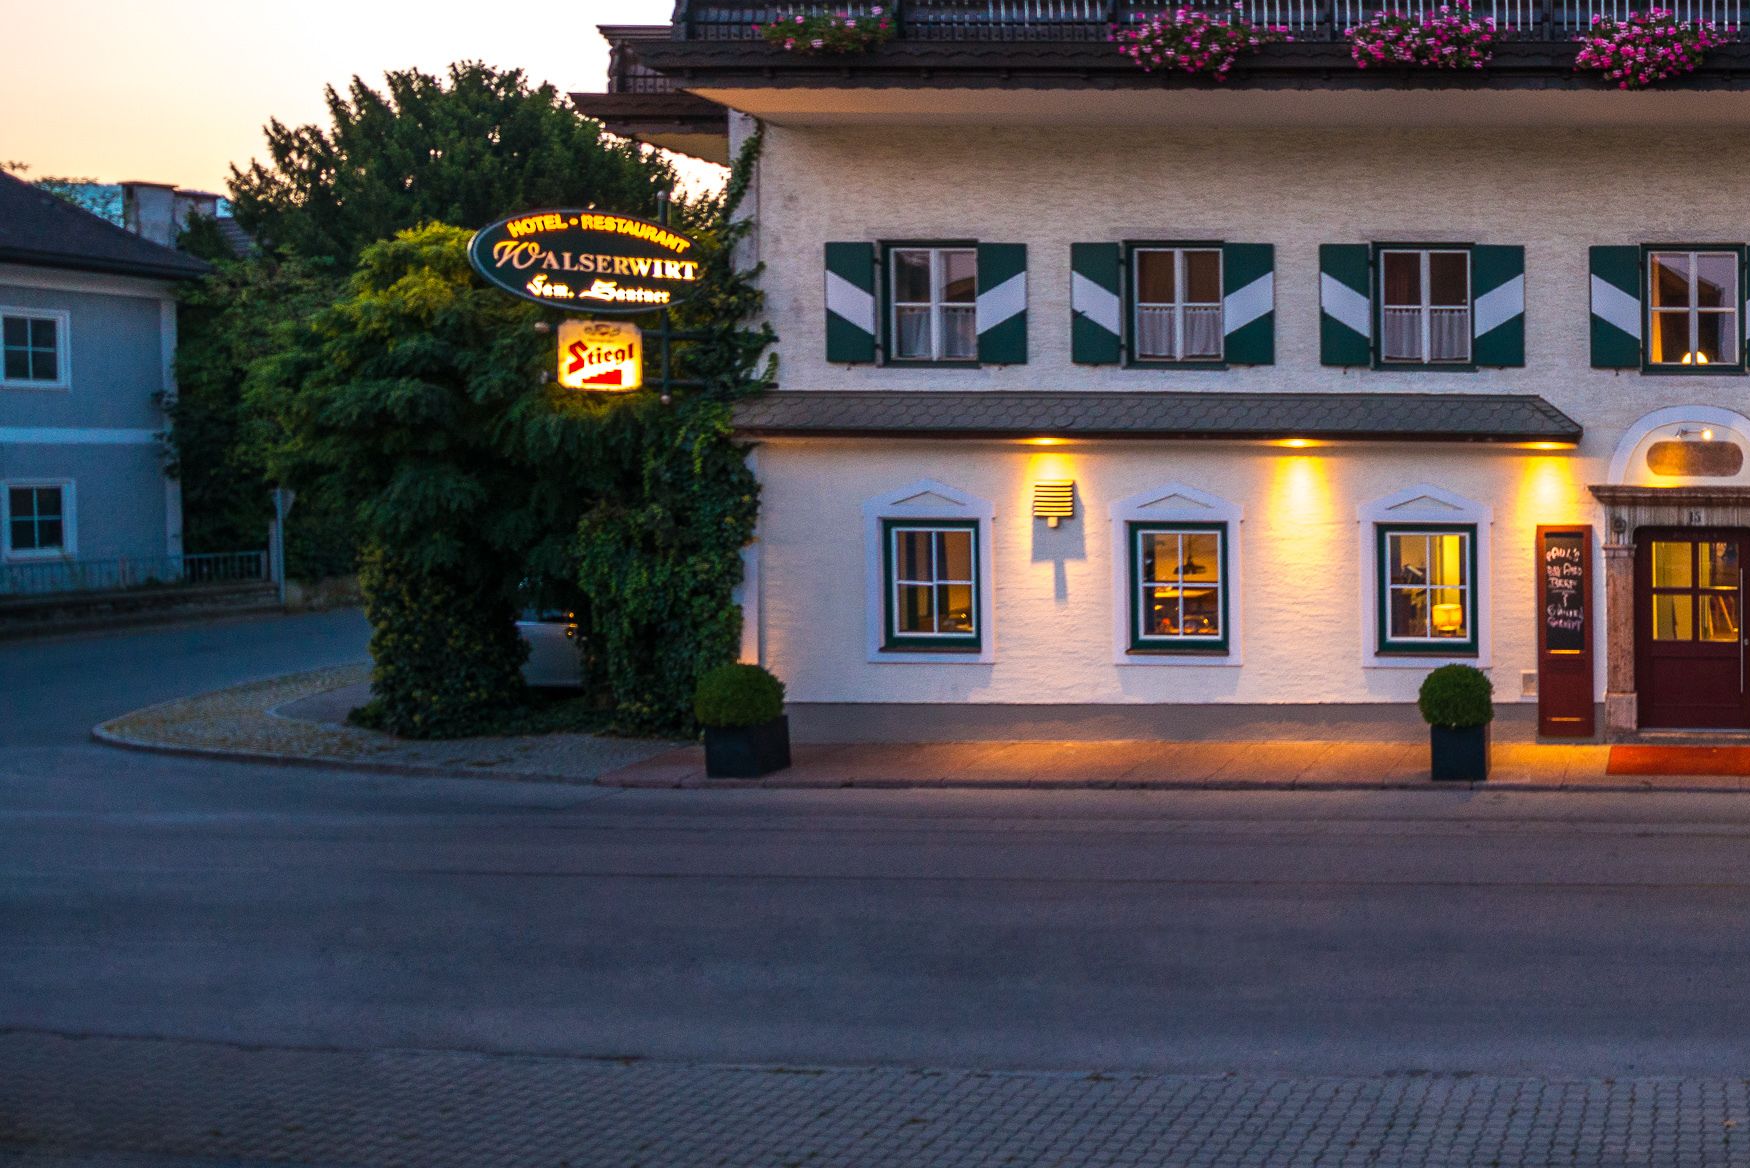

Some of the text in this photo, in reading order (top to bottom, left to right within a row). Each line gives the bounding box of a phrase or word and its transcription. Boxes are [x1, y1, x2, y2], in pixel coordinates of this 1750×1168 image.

[507, 213, 691, 253] HOTEL RESTAURANT
[492, 240, 699, 281] WALSERWIRT
[568, 340, 634, 375] Stiegl
